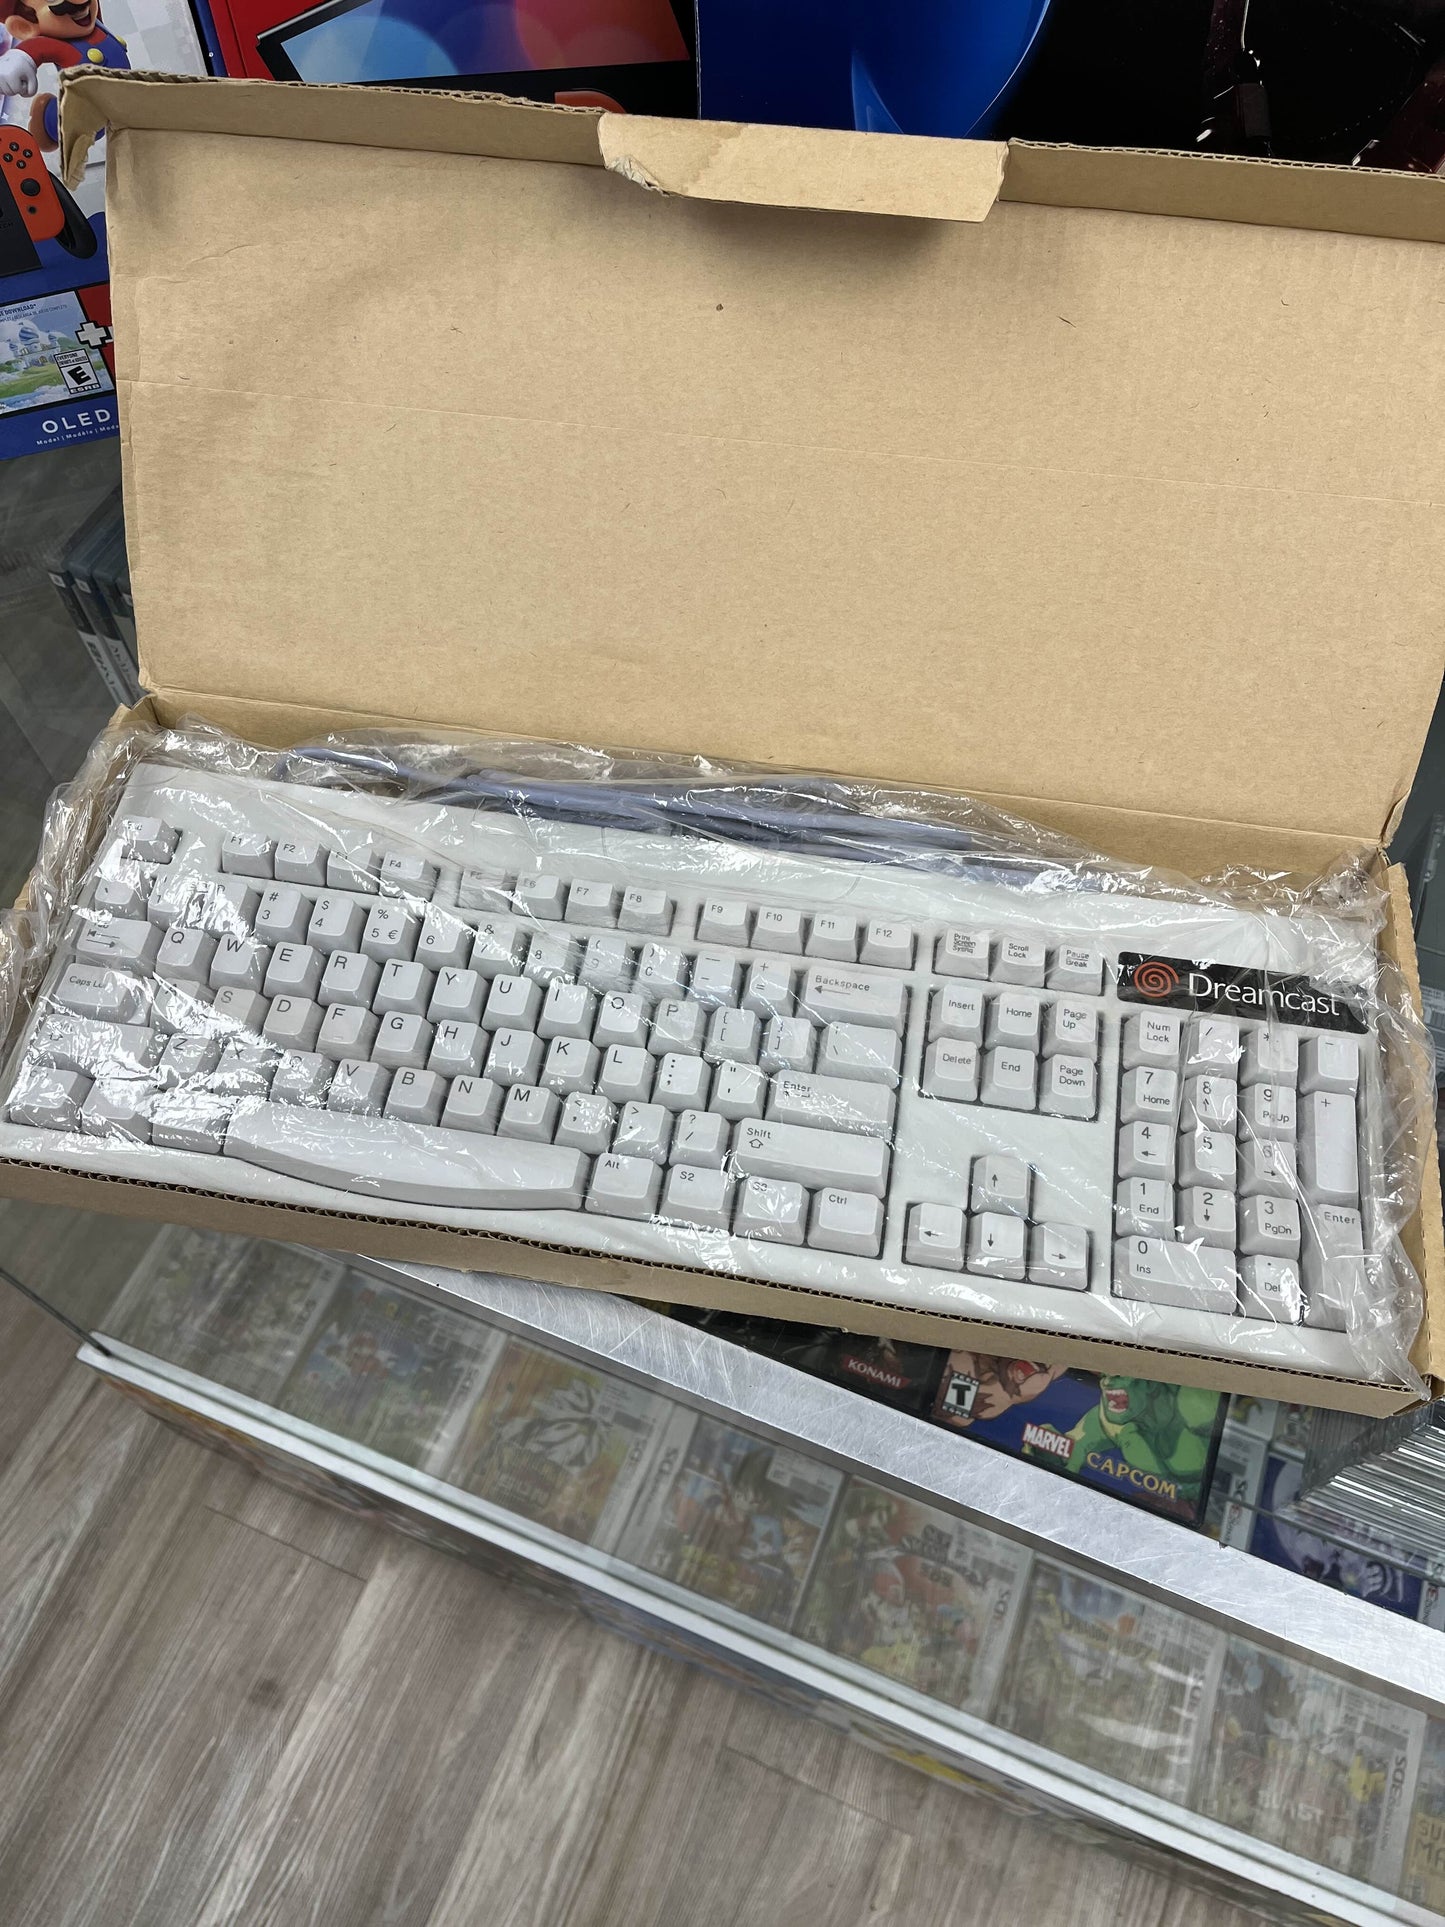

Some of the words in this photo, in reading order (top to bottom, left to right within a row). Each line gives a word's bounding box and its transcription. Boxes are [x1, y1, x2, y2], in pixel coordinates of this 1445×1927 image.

[67, 365, 92, 386] E
[42, 409, 111, 434] OLED
[36, 436, 60, 445] Model
[231, 836, 243, 845] F1
[283, 843, 296, 853] F2
[389, 859, 402, 869] F4
[523, 877, 537, 888] F6
[575, 886, 590, 896] F7
[629, 893, 643, 903] F8
[262, 910, 271, 920] 3
[711, 904, 724, 914] F9
[315, 918, 324, 928] 4
[765, 911, 783, 922] F10
[820, 920, 836, 930] F11
[171, 931, 185, 945] Q
[371, 928, 380, 939] 5
[875, 928, 893, 938] F12
[226, 938, 245, 953] W
[426, 935, 435, 945] 6
[1008, 942, 1029, 952] Scroll
[279, 948, 294, 962] E
[535, 949, 543, 960] 8
[1007, 950, 1027, 959] Lock
[1066, 949, 1090, 960] Pause
[333, 955, 348, 969] R
[1065, 958, 1088, 968] Break
[391, 963, 403, 977] T
[69, 975, 92, 987] Caps
[445, 972, 457, 985] Y
[815, 975, 871, 992] Backspace
[499, 981, 513, 994] U
[1189, 972, 1340, 1016] Dreamcast
[220, 990, 234, 1003] S
[611, 996, 625, 1010] O
[277, 999, 292, 1012] D
[666, 1004, 679, 1017] P
[948, 999, 976, 1011] Insert
[331, 1007, 346, 1020] F
[1005, 1007, 1033, 1019] Home
[1063, 1008, 1087, 1020] Page
[390, 1017, 404, 1030] G
[1062, 1019, 1076, 1030] Up
[1146, 1021, 1171, 1032] Num
[444, 1025, 458, 1040] H
[1146, 1032, 1170, 1043] Lock
[173, 1037, 188, 1051] Z
[500, 1034, 512, 1047] J
[556, 1041, 571, 1056] K
[612, 1050, 624, 1064] L
[942, 1053, 972, 1065] Delete
[346, 1063, 360, 1077] V
[1001, 1061, 1021, 1073] End
[1059, 1065, 1084, 1077] Page
[401, 1071, 415, 1085] B
[1059, 1076, 1086, 1088] Down
[1144, 1071, 1154, 1084] 7
[458, 1080, 473, 1094] N
[783, 1080, 812, 1092] Enter
[1202, 1081, 1211, 1094] 8
[513, 1088, 531, 1102] M
[1143, 1094, 1171, 1106] Home
[1263, 1088, 1272, 1102] 9
[746, 1127, 772, 1140] Shift
[1141, 1126, 1151, 1139] 4
[1203, 1136, 1213, 1150] 5
[1262, 1145, 1272, 1158] 6
[604, 1159, 620, 1170] Alt
[680, 1170, 695, 1182] S2
[1139, 1183, 1147, 1195] 1
[828, 1194, 848, 1205] Ctrl
[1203, 1192, 1214, 1206] 2
[1139, 1203, 1160, 1215] End
[1264, 1201, 1275, 1214] 3
[1324, 1211, 1356, 1225] Enter
[1265, 1223, 1292, 1235] PgDn
[1137, 1240, 1148, 1254] 0
[1136, 1263, 1151, 1274] Ins
[1264, 1281, 1281, 1293] Del
[848, 1359, 902, 1388] KONAMI
[951, 1383, 971, 1406] T
[1022, 1423, 1071, 1458] MARVEL
[1086, 1451, 1177, 1499] CAPCOM
[1417, 1819, 1445, 1843] SU
